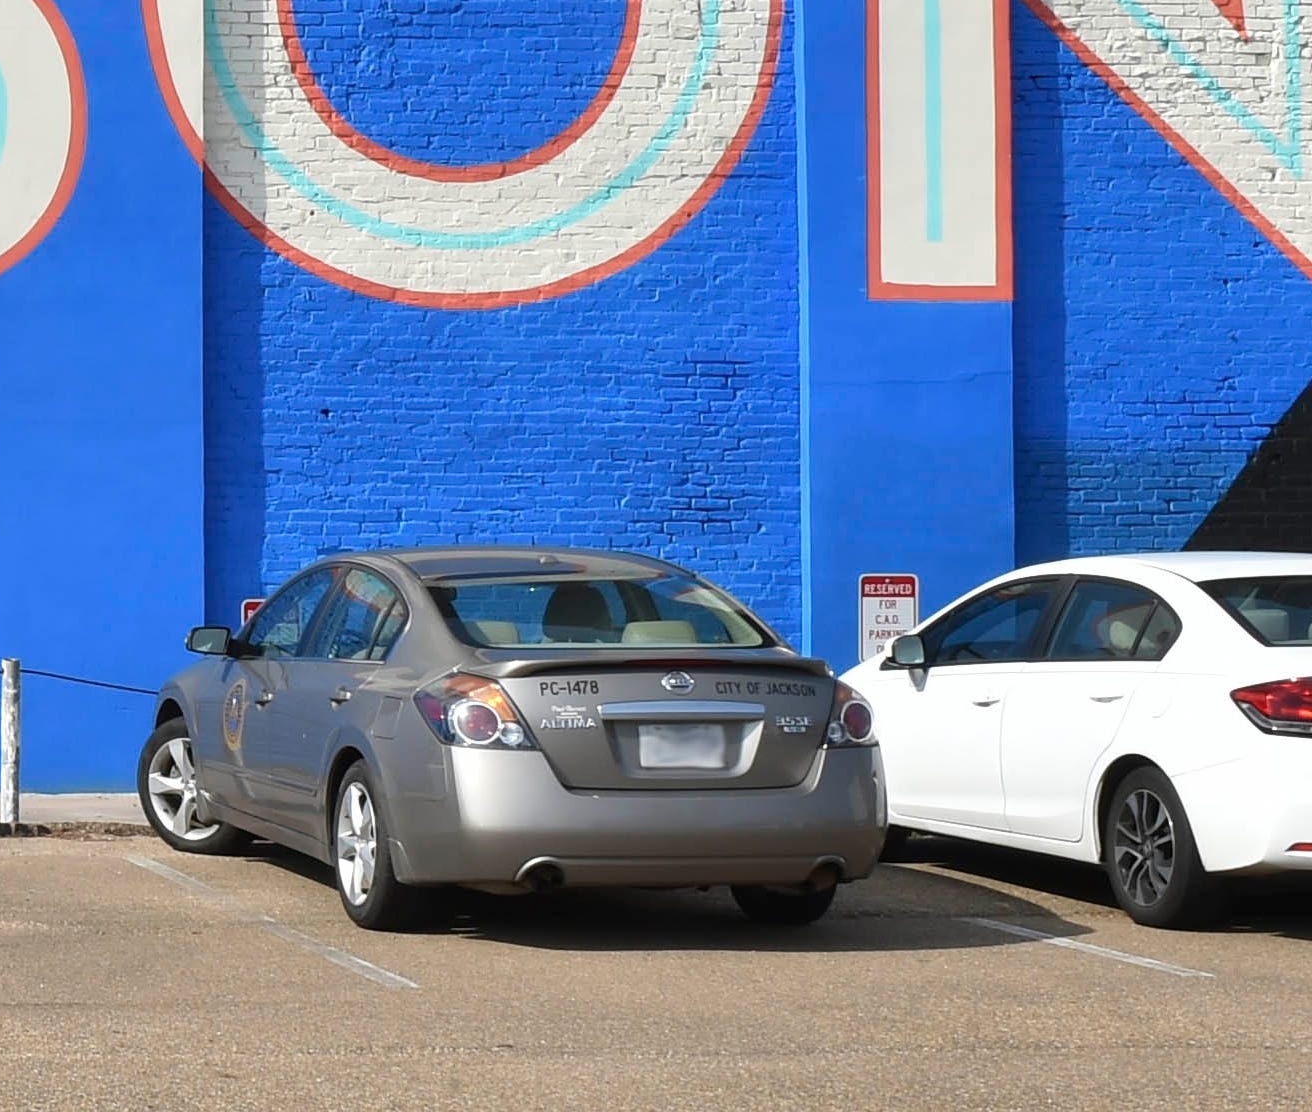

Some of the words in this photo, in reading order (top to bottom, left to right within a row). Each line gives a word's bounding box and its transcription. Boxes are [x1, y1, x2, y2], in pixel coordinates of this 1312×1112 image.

[864, 583, 912, 595] RESERVED
[879, 599, 897, 609] FOR
[539, 680, 599, 696] PC-1478
[715, 681, 741, 695] CITY
[746, 682, 762, 695] OF
[765, 682, 816, 697] JACKSON
[540, 717, 597, 729] ALTIMA
